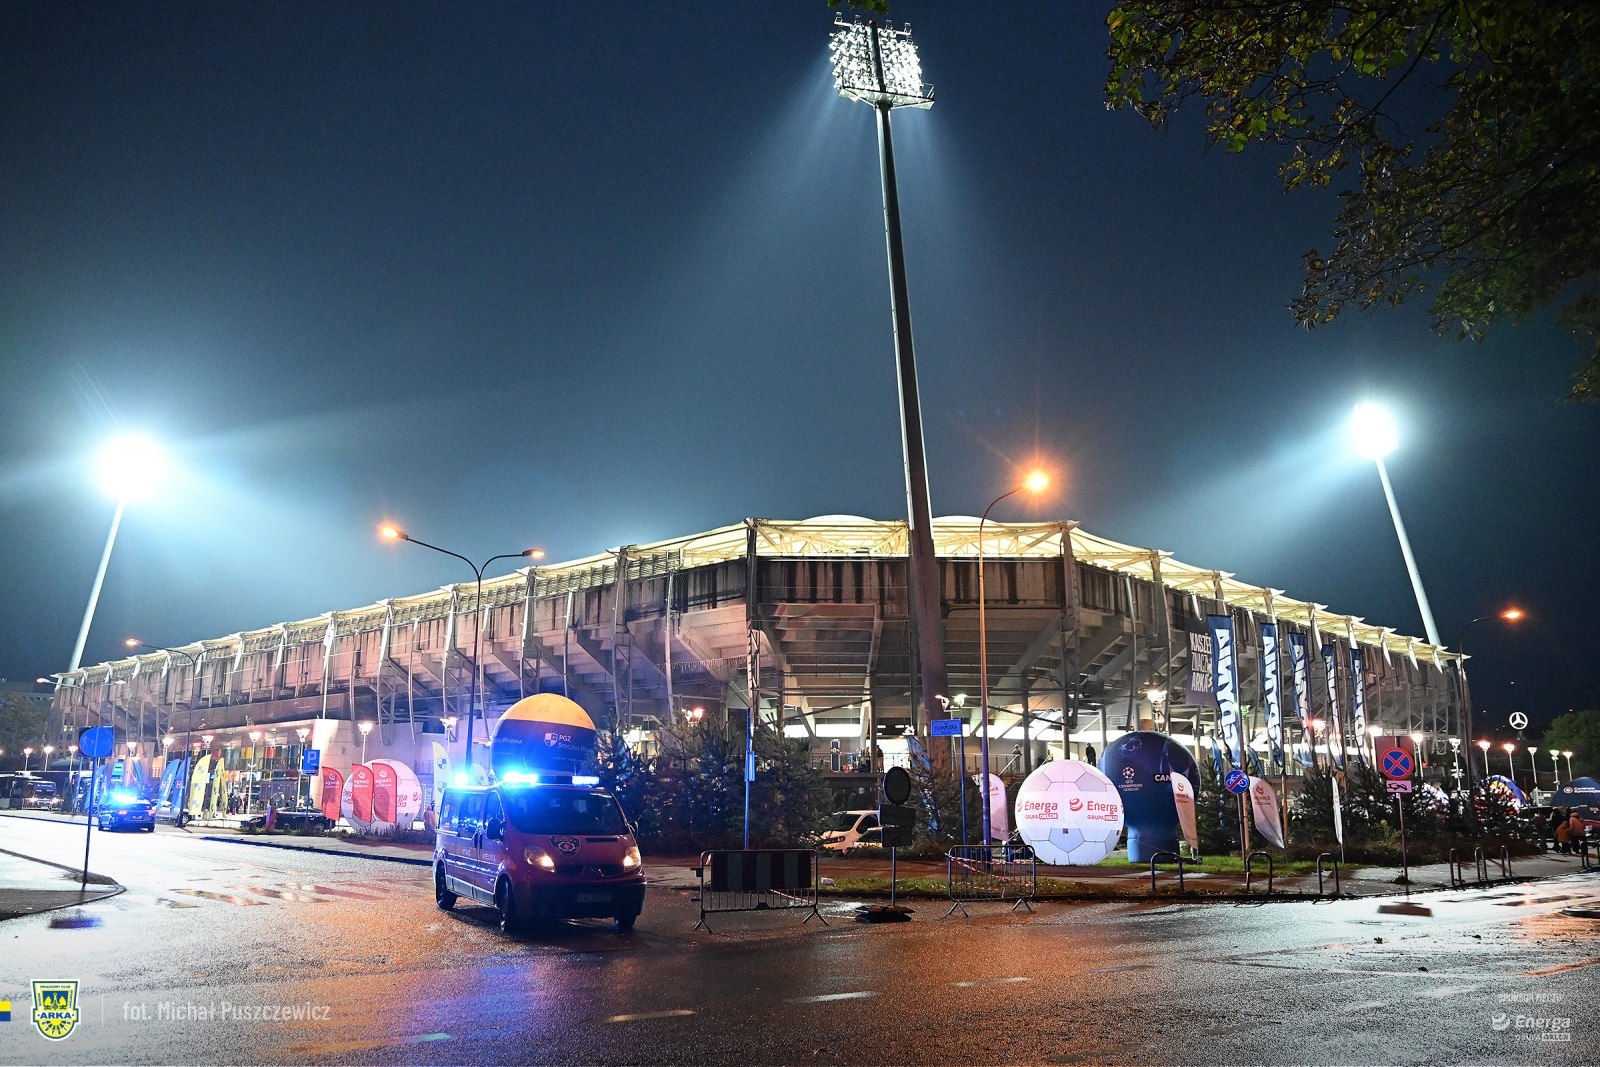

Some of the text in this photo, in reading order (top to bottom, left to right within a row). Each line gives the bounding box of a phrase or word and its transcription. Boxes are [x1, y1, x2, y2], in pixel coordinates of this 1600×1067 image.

[1191, 672, 1208, 693] ARKA
[558, 734, 572, 742] PGZ
[307, 751, 317, 764] P
[1154, 774, 1173, 782] CAN
[1024, 801, 1058, 813] Energa
[1087, 801, 1118, 814] Energa
